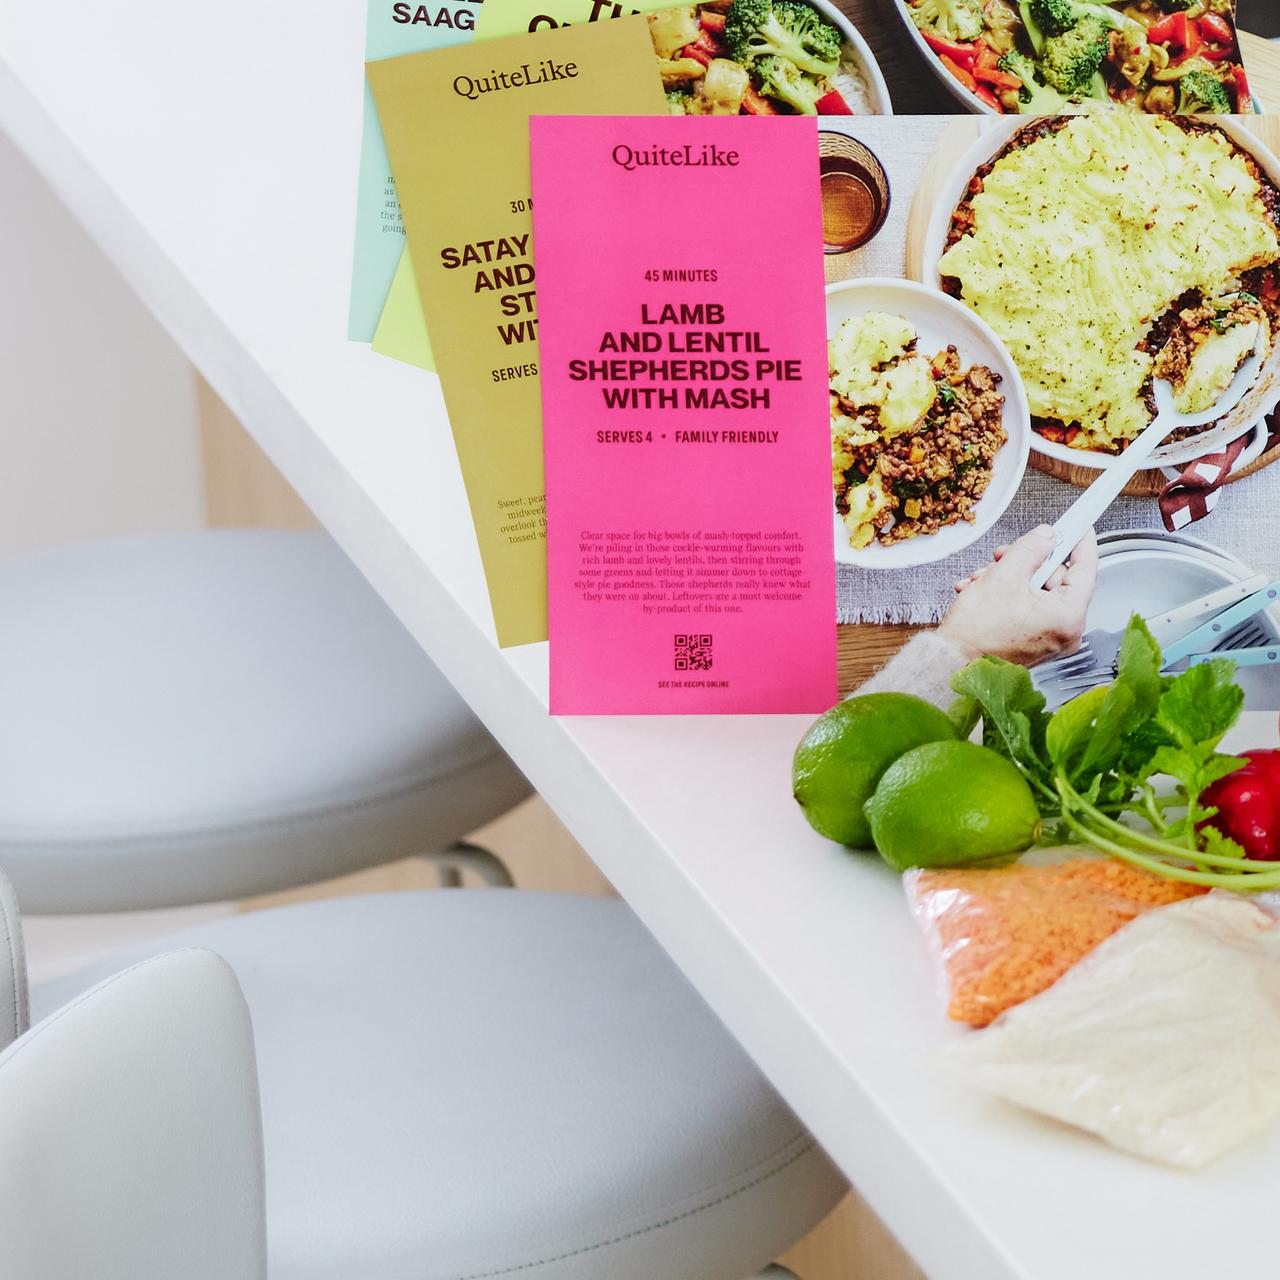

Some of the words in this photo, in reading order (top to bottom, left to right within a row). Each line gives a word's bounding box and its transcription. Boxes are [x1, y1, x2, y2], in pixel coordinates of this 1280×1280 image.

[392, 3, 475, 31] SAAG
[453, 59, 579, 100] QuiteLike
[612, 144, 740, 171] QuiteLike
[510, 200, 525, 213] 30
[440, 233, 529, 269] SATAY
[474, 263, 535, 294] AND
[645, 269, 659, 282] 45
[663, 269, 718, 282] MINUTES
[641, 304, 725, 325] LAMB
[599, 332, 662, 353] AND
[669, 332, 770, 353] LENTIL
[492, 363, 538, 383] SERVES
[569, 359, 750, 381] SHEPHERDS
[756, 360, 803, 381] PIE
[602, 388, 679, 409] WITH
[685, 388, 770, 409] MASH
[597, 431, 645, 443] SERVES
[645, 431, 653, 443] 4
[675, 431, 719, 443] FAMILY
[721, 431, 779, 443] FRIENDLY
[581, 531, 603, 540] Clear
[606, 533, 630, 542] space
[633, 531, 647, 540] for
[648, 531, 662, 542] big
[665, 531, 689, 540] bowls
[693, 531, 702, 540] of
[704, 531, 761, 542] mash-topped
[606, 543, 632, 554] piling
[635, 544, 644, 552] in
[647, 543, 670, 552] those
[672, 543, 743, 554] cockle-warming
[746, 543, 782, 553] flavours
[784, 543, 804, 552] with
[582, 555, 600, 564] rich
[603, 555, 625, 564] lamb
[627, 556, 643, 564] and
[646, 556, 671, 566] lovely
[708, 556, 727, 565] then
[730, 556, 763, 566] stirring
[766, 556, 801, 566] through
[604, 569, 633, 578] greens
[636, 568, 652, 576] and
[656, 568, 684, 578] letting
[688, 568, 693, 576] it
[696, 568, 729, 577] simmer
[732, 568, 756, 577] down
[759, 569, 768, 577] to
[574, 580, 594, 590] style
[597, 580, 611, 590] pie
[659, 580, 685, 589] Those
[688, 580, 733, 590] shepherds
[736, 580, 760, 590] really
[763, 580, 785, 589] knew
[789, 580, 811, 589] what
[583, 592, 602, 602] they
[672, 592, 713, 601] Leftovers
[740, 593, 761, 601] most
[764, 592, 802, 601] welcome
[643, 604, 691, 615] by-product
[693, 604, 702, 613] of
[704, 604, 722, 613] this
[724, 605, 744, 613] one.
